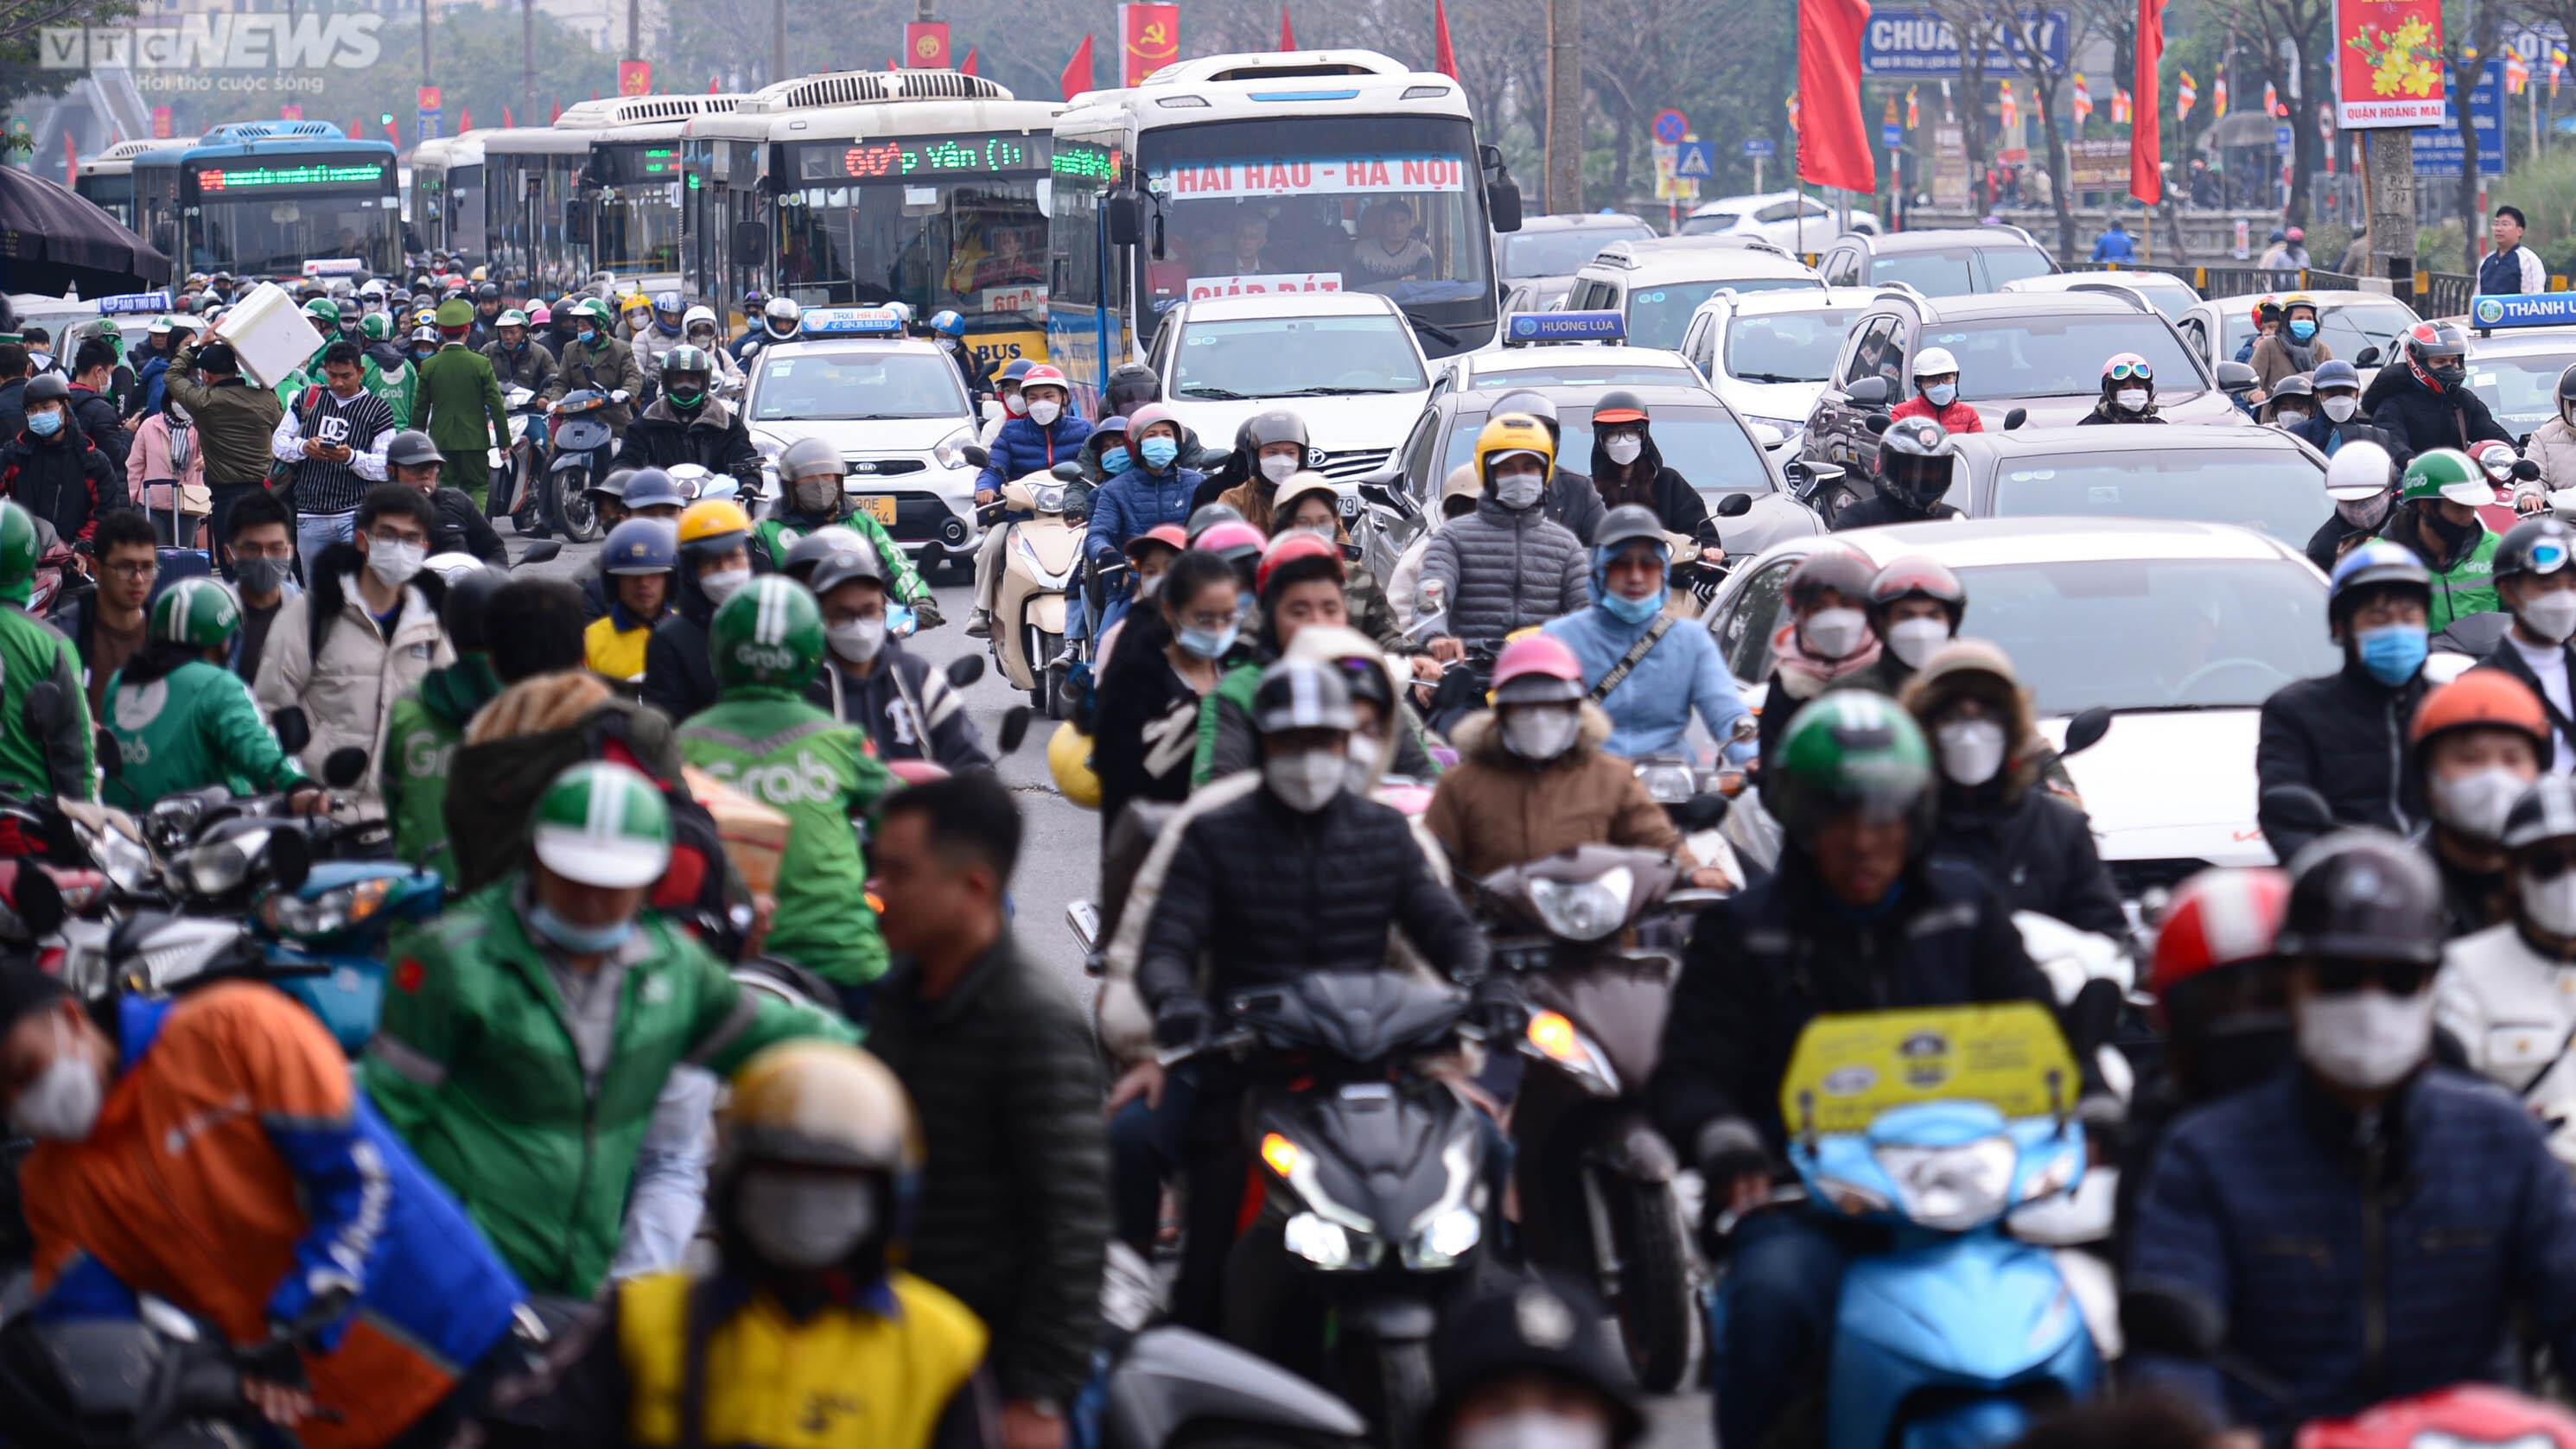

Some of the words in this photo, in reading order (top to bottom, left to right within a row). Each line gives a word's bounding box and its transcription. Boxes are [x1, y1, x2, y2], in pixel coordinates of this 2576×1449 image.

[2505, 299, 2565, 317] THÀNH
[1542, 320, 1587, 333] HƯƠNG
[1589, 317, 1615, 331] LÚA
[976, 342, 1022, 362] BUS
[378, 388, 404, 399] Grab
[735, 644, 794, 670] Grab
